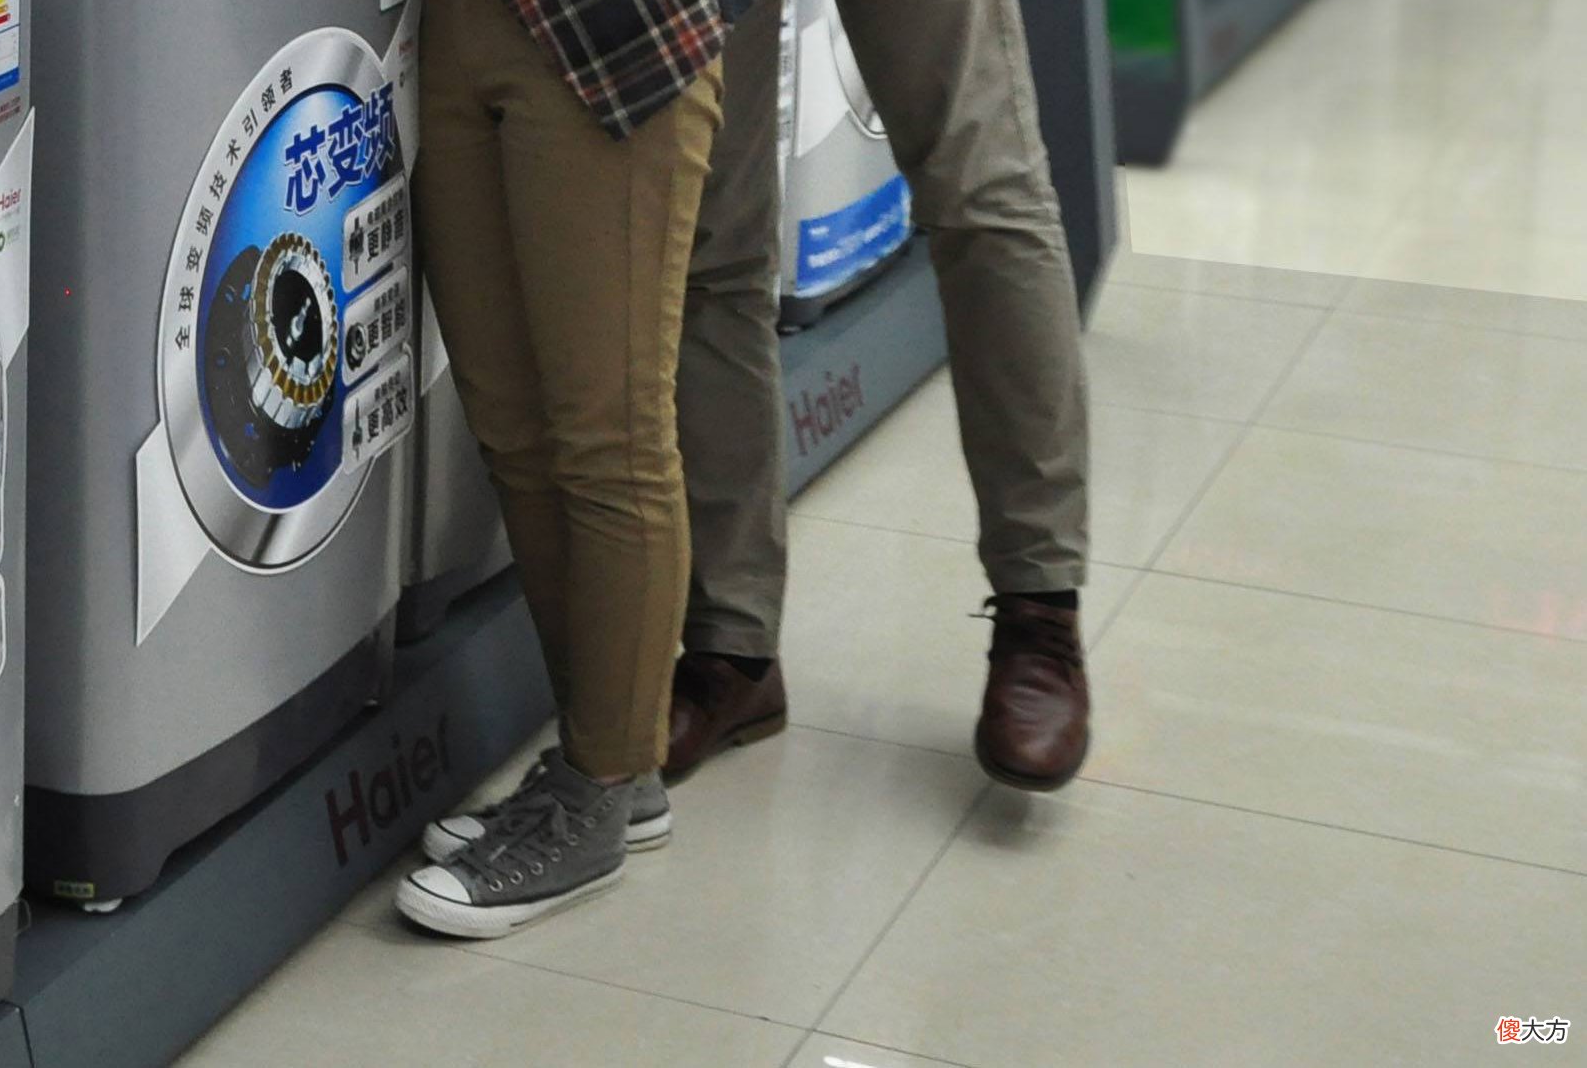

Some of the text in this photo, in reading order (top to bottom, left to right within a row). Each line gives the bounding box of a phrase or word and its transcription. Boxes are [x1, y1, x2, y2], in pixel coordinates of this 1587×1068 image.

[175, 67, 294, 351] 全球变频技术引领者
[283, 82, 394, 214] 芯变频
[790, 363, 865, 457] Haier
[325, 713, 450, 868] Haier
